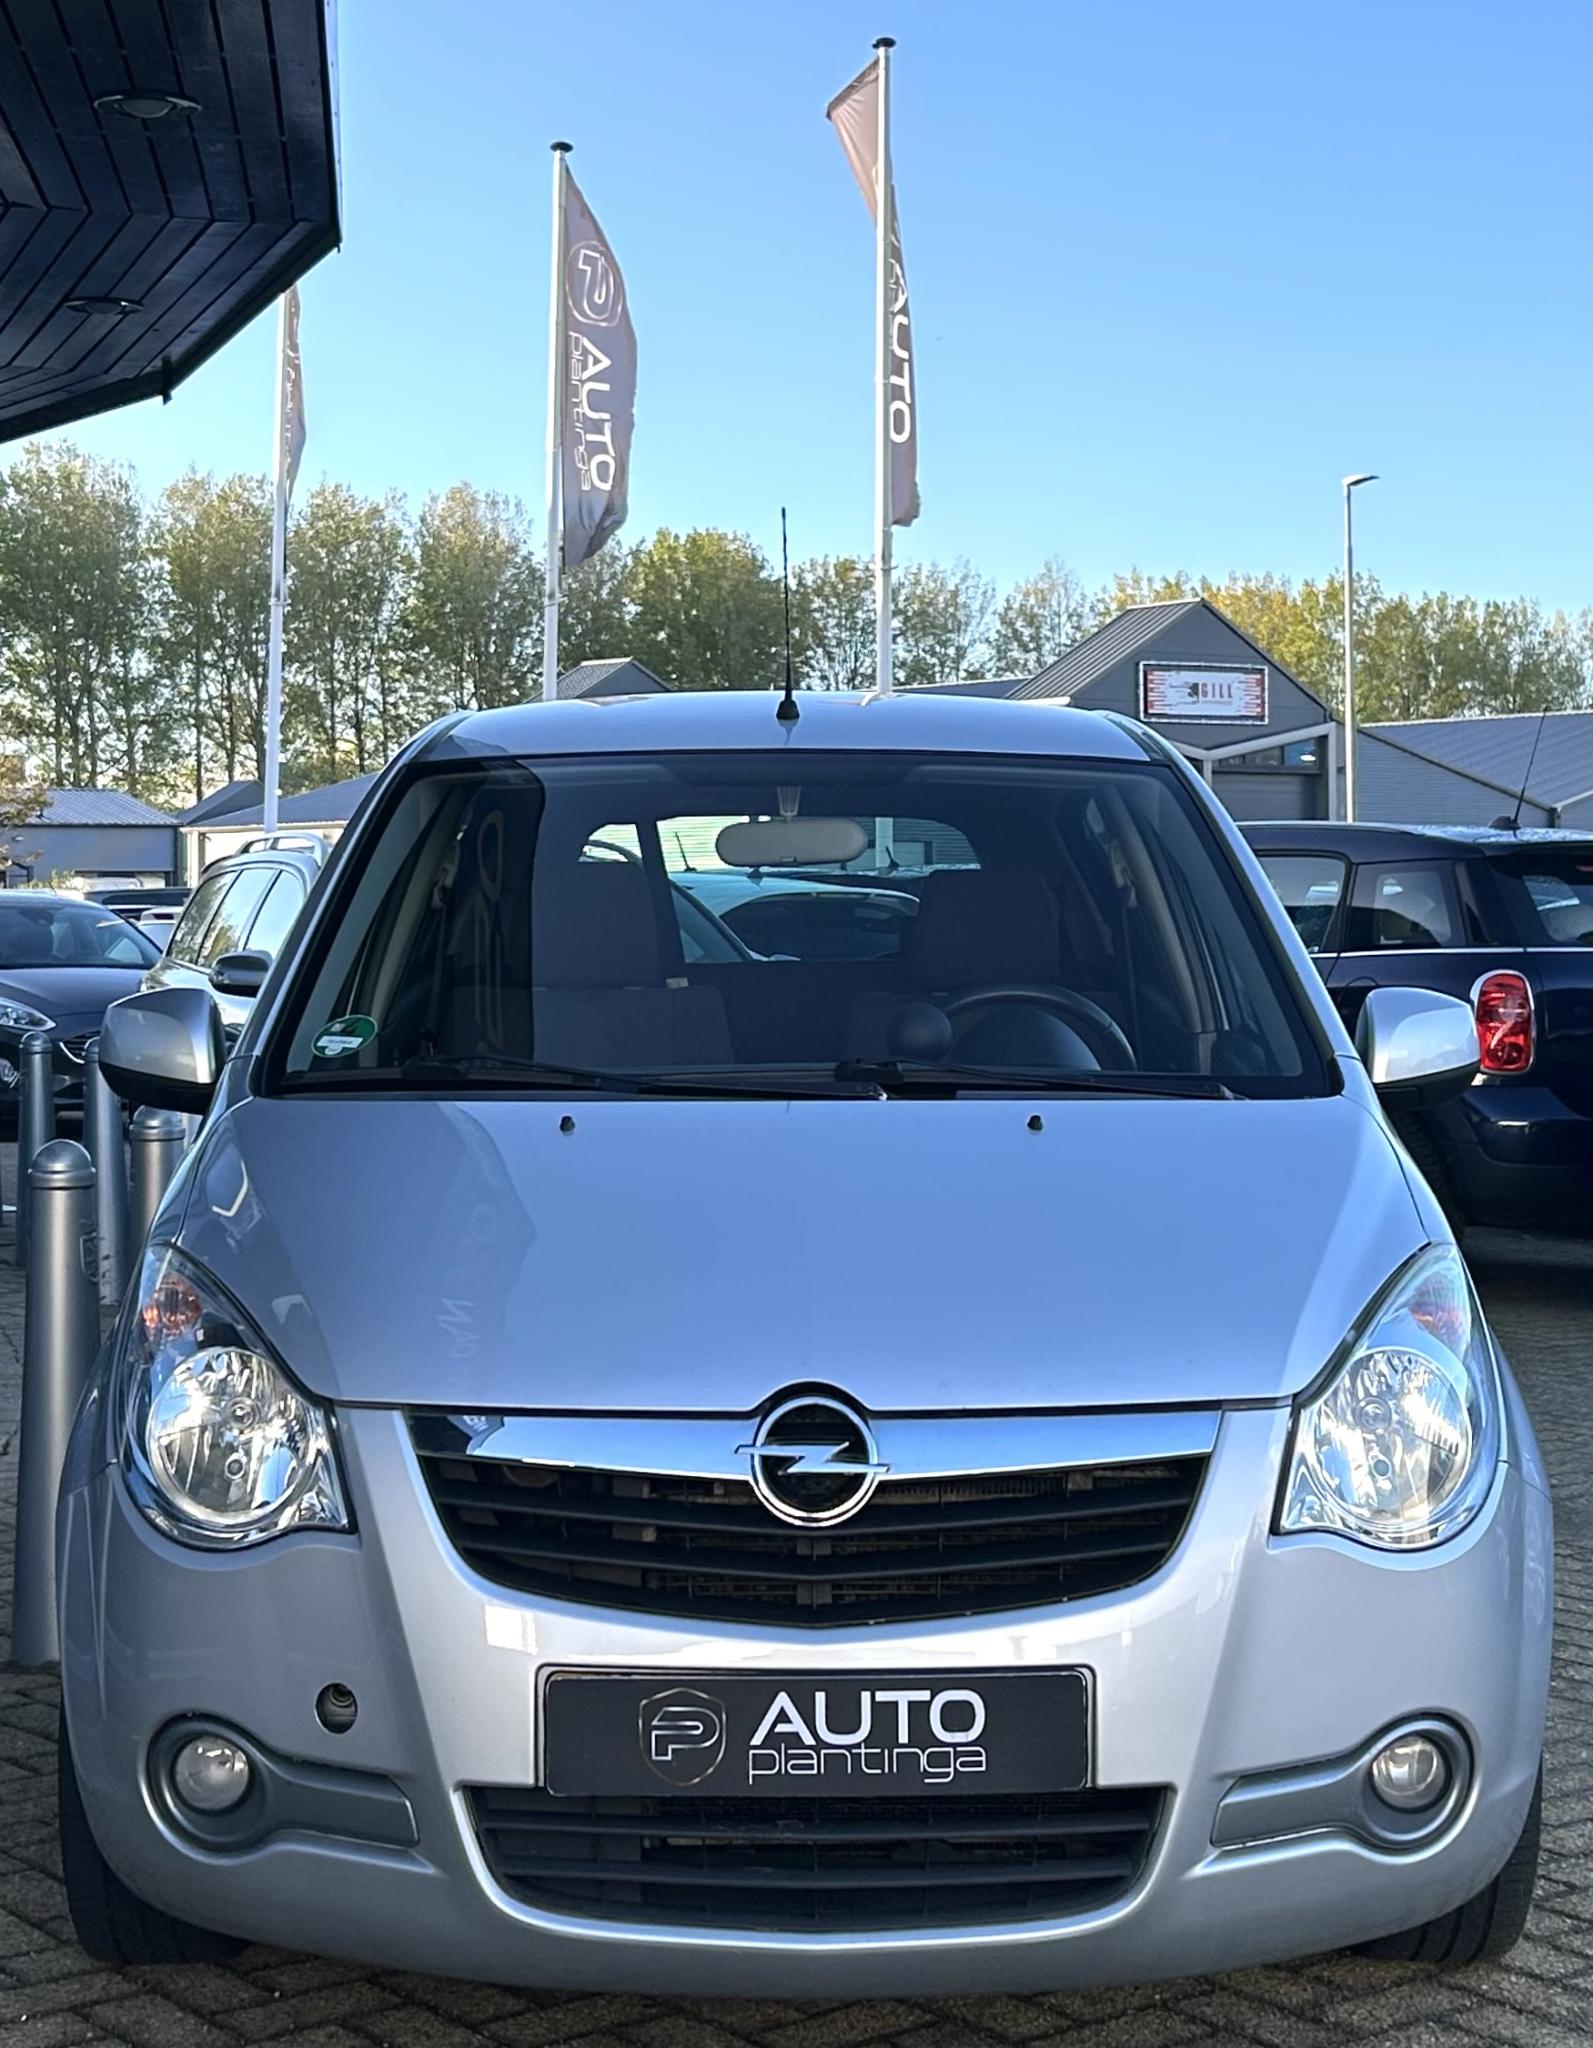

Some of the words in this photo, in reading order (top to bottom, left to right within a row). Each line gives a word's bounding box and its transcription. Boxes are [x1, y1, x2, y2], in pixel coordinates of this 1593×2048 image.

[568, 331, 591, 491] plantinga
[582, 337, 616, 491] AUTO
[889, 262, 912, 443] AUTO
[749, 1689, 986, 1745] AUTO
[749, 1744, 986, 1784] plantinga
